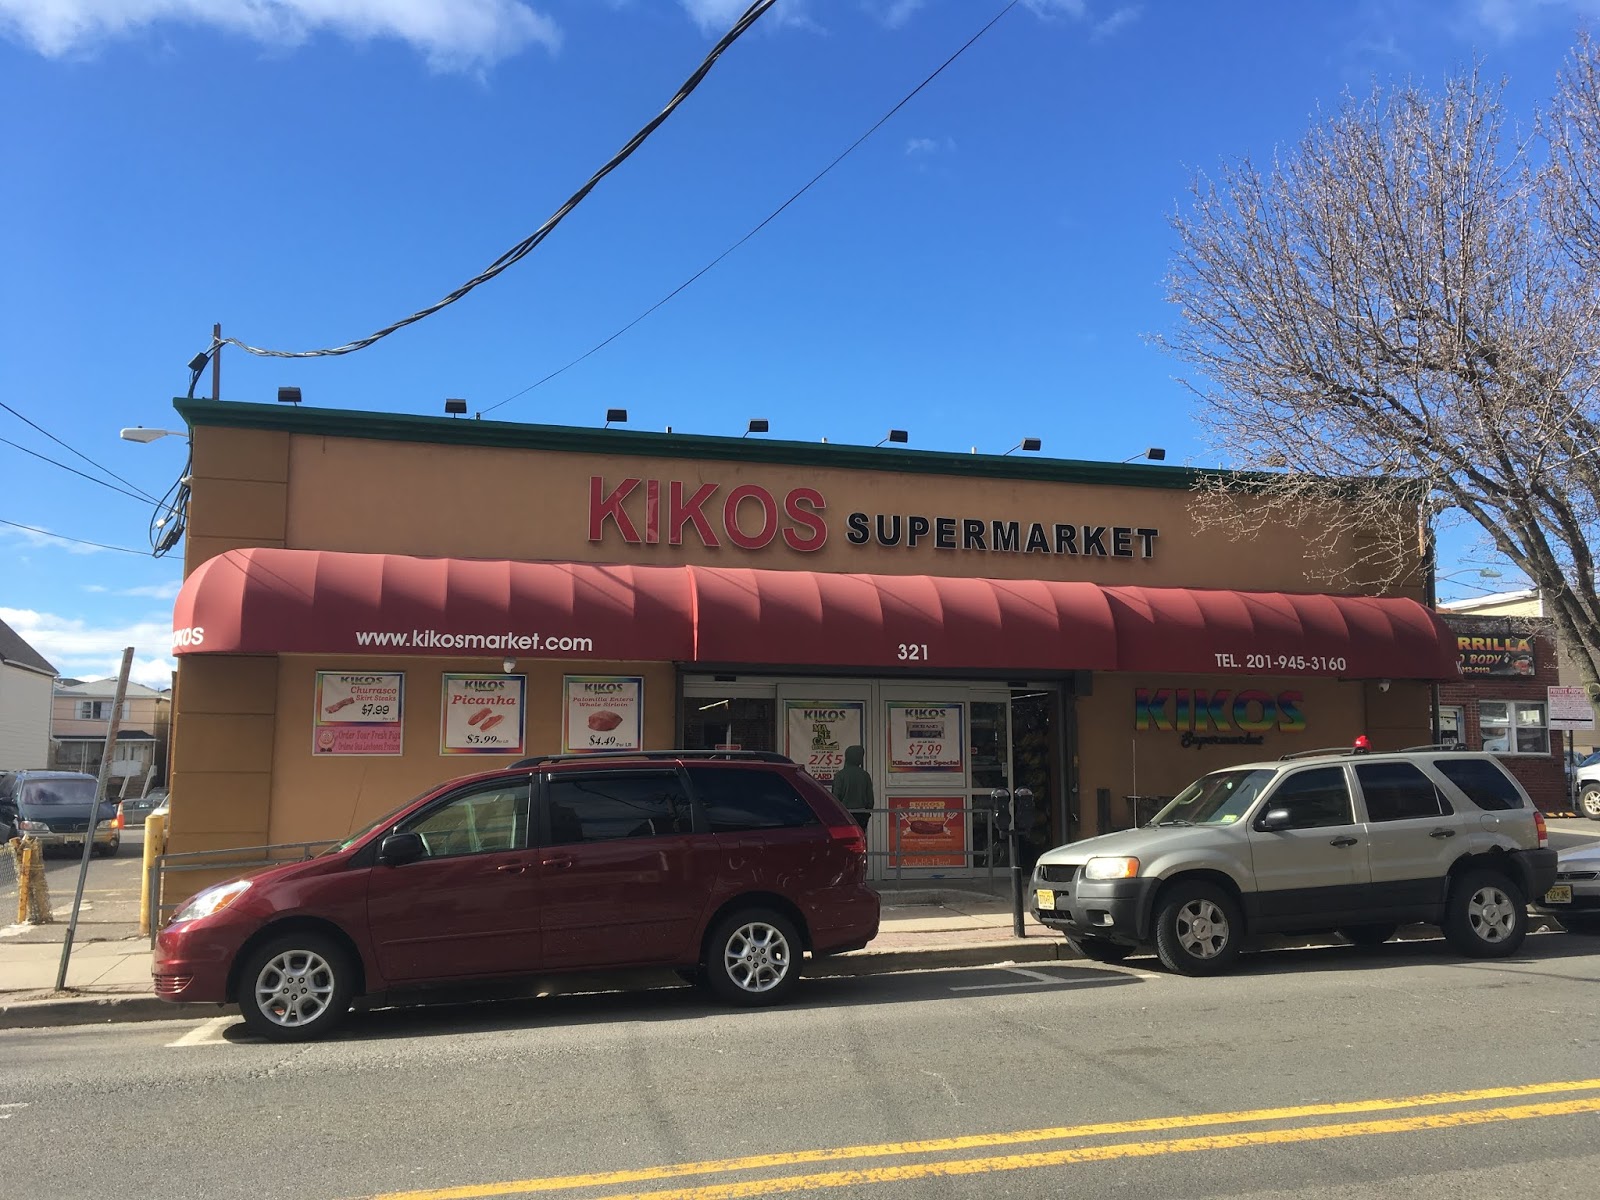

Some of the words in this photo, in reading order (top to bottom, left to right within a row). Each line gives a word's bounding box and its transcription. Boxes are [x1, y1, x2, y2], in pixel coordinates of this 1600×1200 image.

[588, 476, 828, 552] KIKOS
[846, 512, 1160, 559] SUPERMARKET
[355, 629, 593, 652] www.kikosmarket.com
[1457, 636, 1531, 652] RRILLA
[897, 643, 928, 661] 321
[1215, 653, 1241, 667] TEL.
[1246, 654, 1346, 671] 201-945-3160
[1469, 654, 1501, 664] BODY
[350, 686, 397, 694] Churrasco
[464, 681, 505, 689] KIKOS
[584, 683, 623, 692] KIKOS
[374, 694, 396, 702] Steaks
[451, 694, 516, 705] Picanha
[362, 704, 389, 716] $7.99
[804, 710, 846, 720] KIKOS
[905, 709, 946, 718] KIKOS
[1134, 688, 1307, 733] KIKOS
[466, 734, 497, 744] $5.99
[589, 734, 616, 746] $4.49
[908, 744, 942, 756] $7.99
